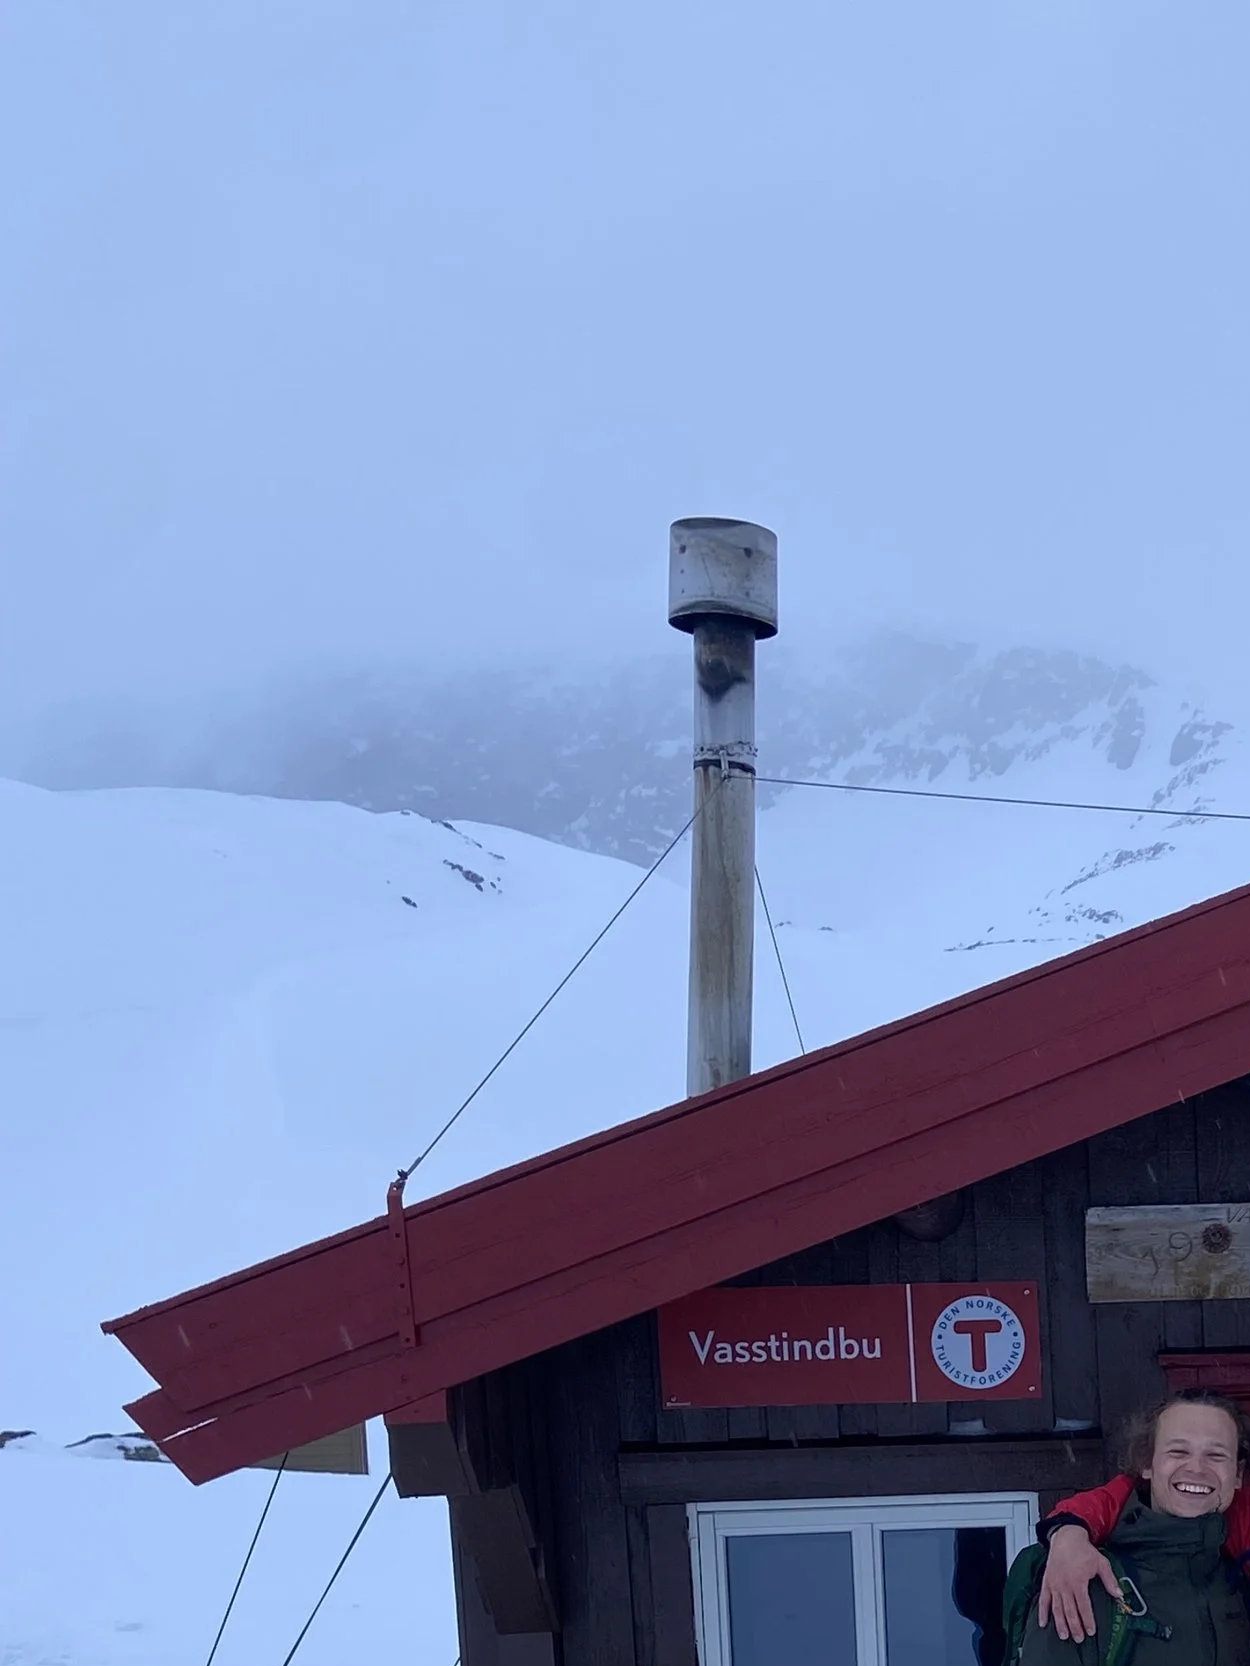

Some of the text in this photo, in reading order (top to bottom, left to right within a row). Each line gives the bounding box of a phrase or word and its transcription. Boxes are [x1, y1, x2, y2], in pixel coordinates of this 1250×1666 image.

[938, 1299, 1016, 1330] DEN NORSKE
[688, 1326, 882, 1366] Vasstindbu
[935, 1341, 1021, 1385] TURISTFORENING
